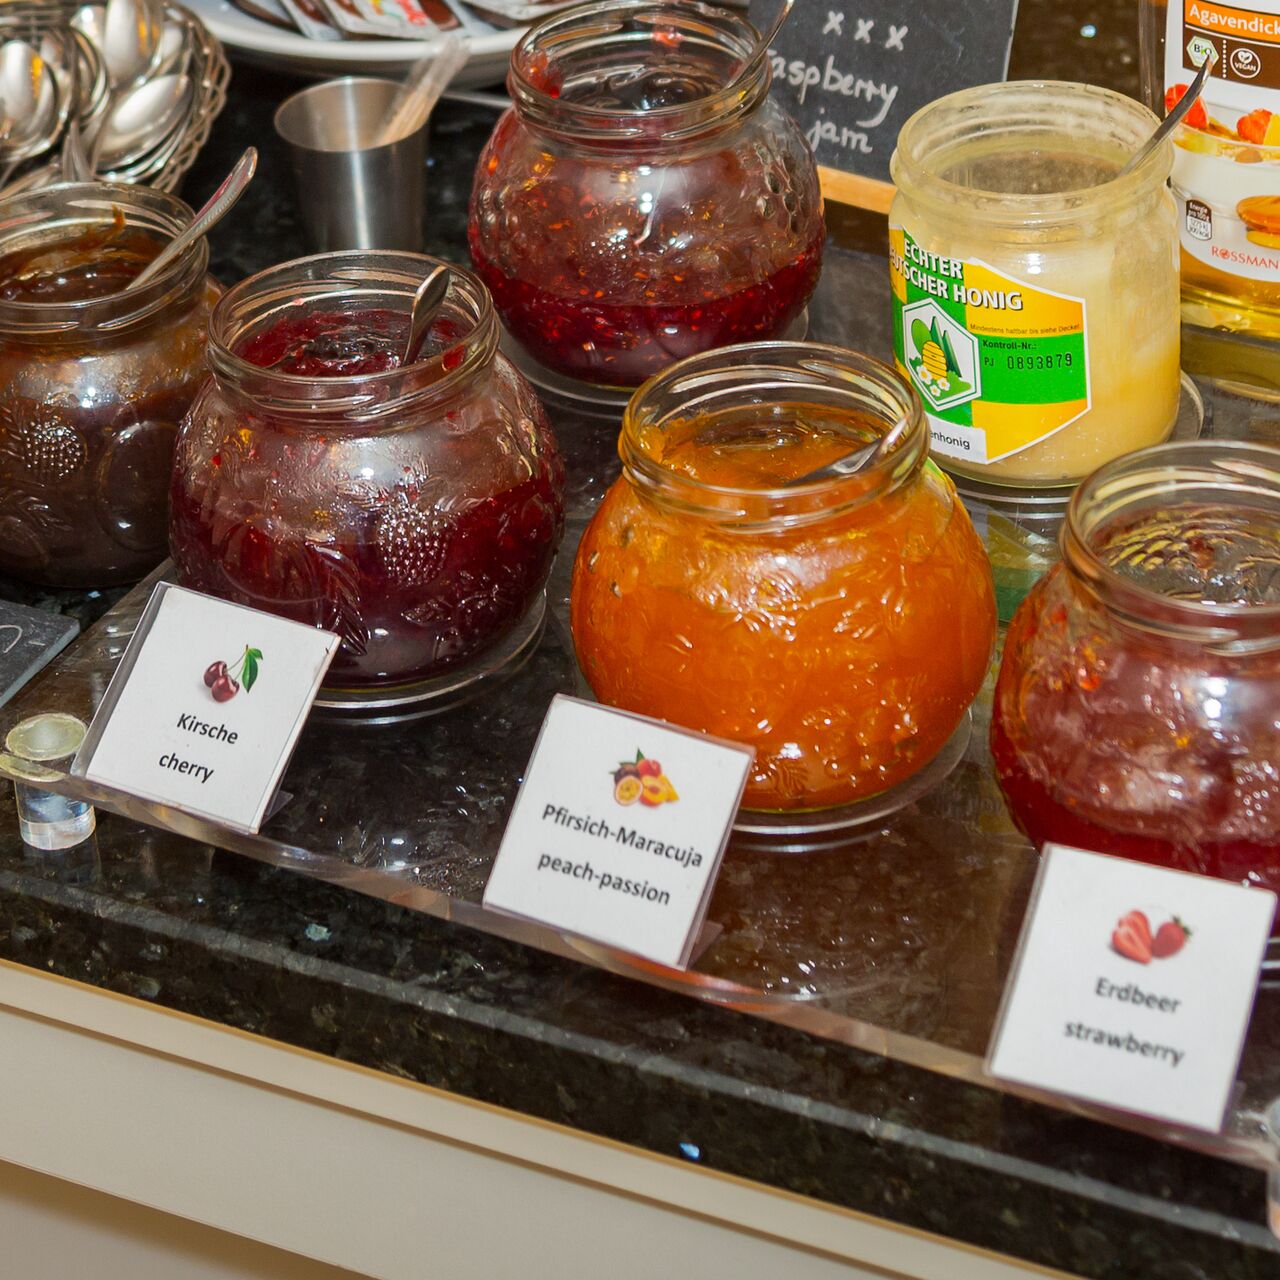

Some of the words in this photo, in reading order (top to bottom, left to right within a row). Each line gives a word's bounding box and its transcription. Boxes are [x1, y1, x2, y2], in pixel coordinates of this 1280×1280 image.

[1233, 60, 1256, 73] VEGAN
[807, 107, 873, 154] jam
[904, 237, 963, 280] ECHTER
[953, 283, 1023, 310] HONIG
[176, 713, 239, 745] Kirsche
[158, 753, 214, 784] cherry
[542, 803, 703, 868] Pfirsich-Maracuja
[537, 852, 671, 906] peach-passion
[1095, 976, 1182, 1014] Erdbeer
[1064, 1021, 1185, 1068] strawberry
